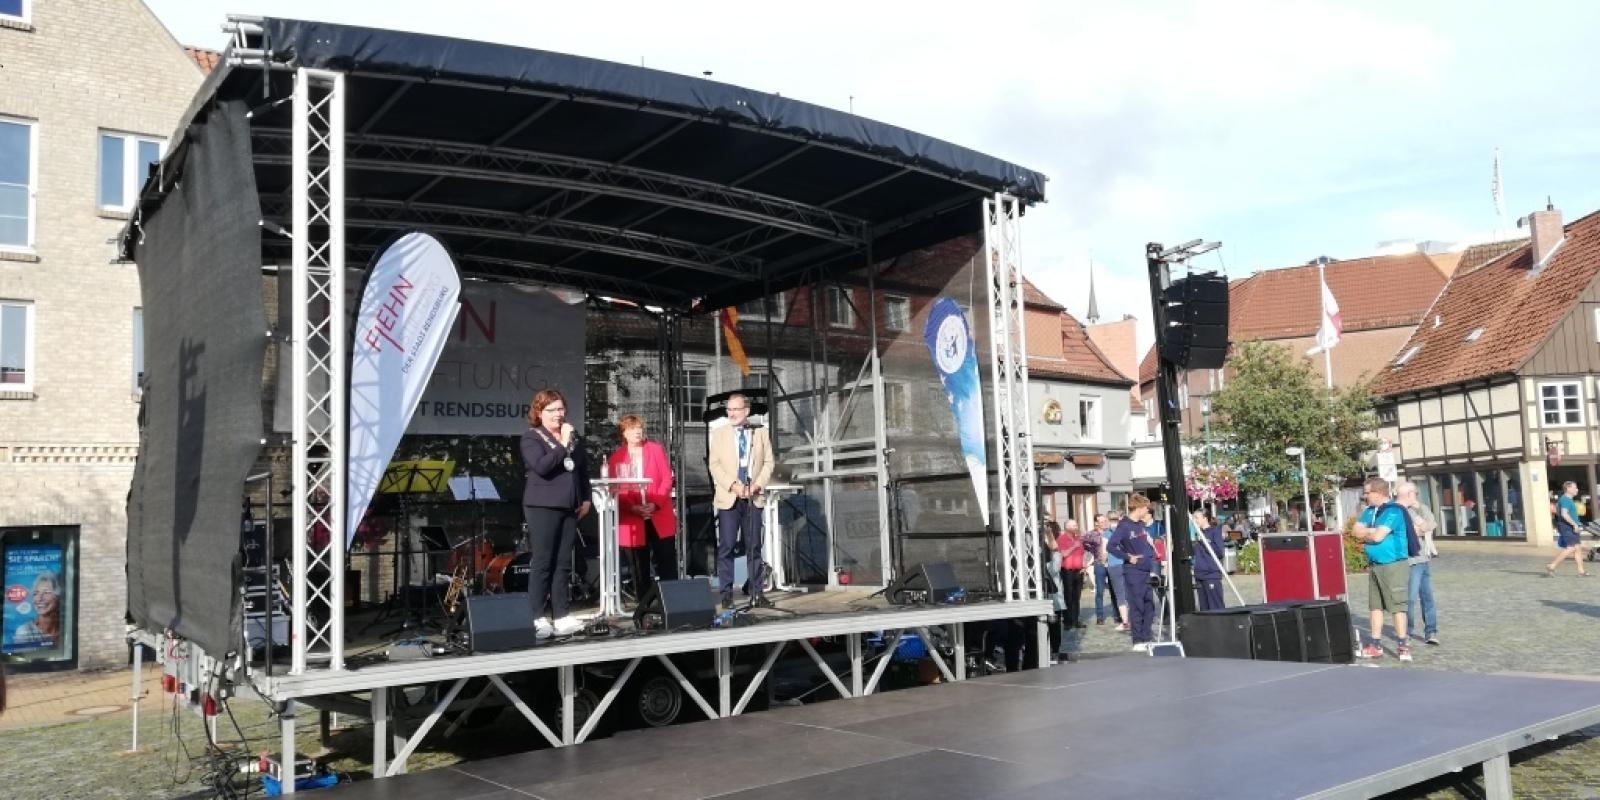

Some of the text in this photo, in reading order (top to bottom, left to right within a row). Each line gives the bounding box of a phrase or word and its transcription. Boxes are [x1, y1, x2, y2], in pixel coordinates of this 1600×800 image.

[401, 286, 449, 374] DER STADT RENDSBURG
[433, 360, 548, 391] FTUNG
[433, 401, 531, 418] RENDSBUR
